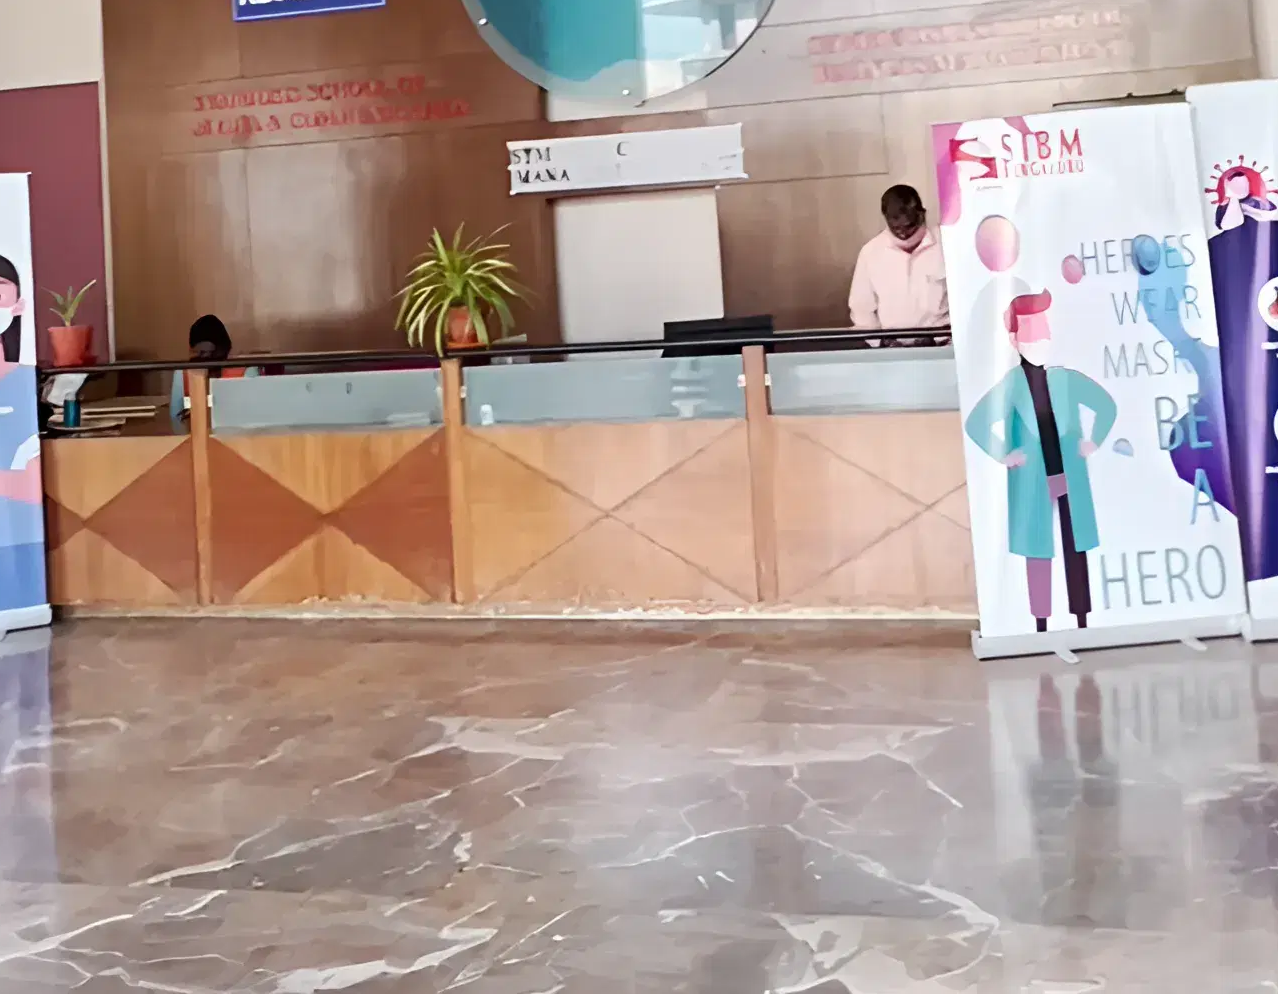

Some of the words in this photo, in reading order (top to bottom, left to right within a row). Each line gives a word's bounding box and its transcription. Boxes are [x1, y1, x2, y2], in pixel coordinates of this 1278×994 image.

[1001, 127, 1083, 162] SIBM
[1080, 233, 1196, 276] HEROES
[1111, 285, 1202, 325] WEAR
[1155, 394, 1213, 451] BE
[1190, 467, 1221, 525] A
[1100, 544, 1227, 610] HERO
